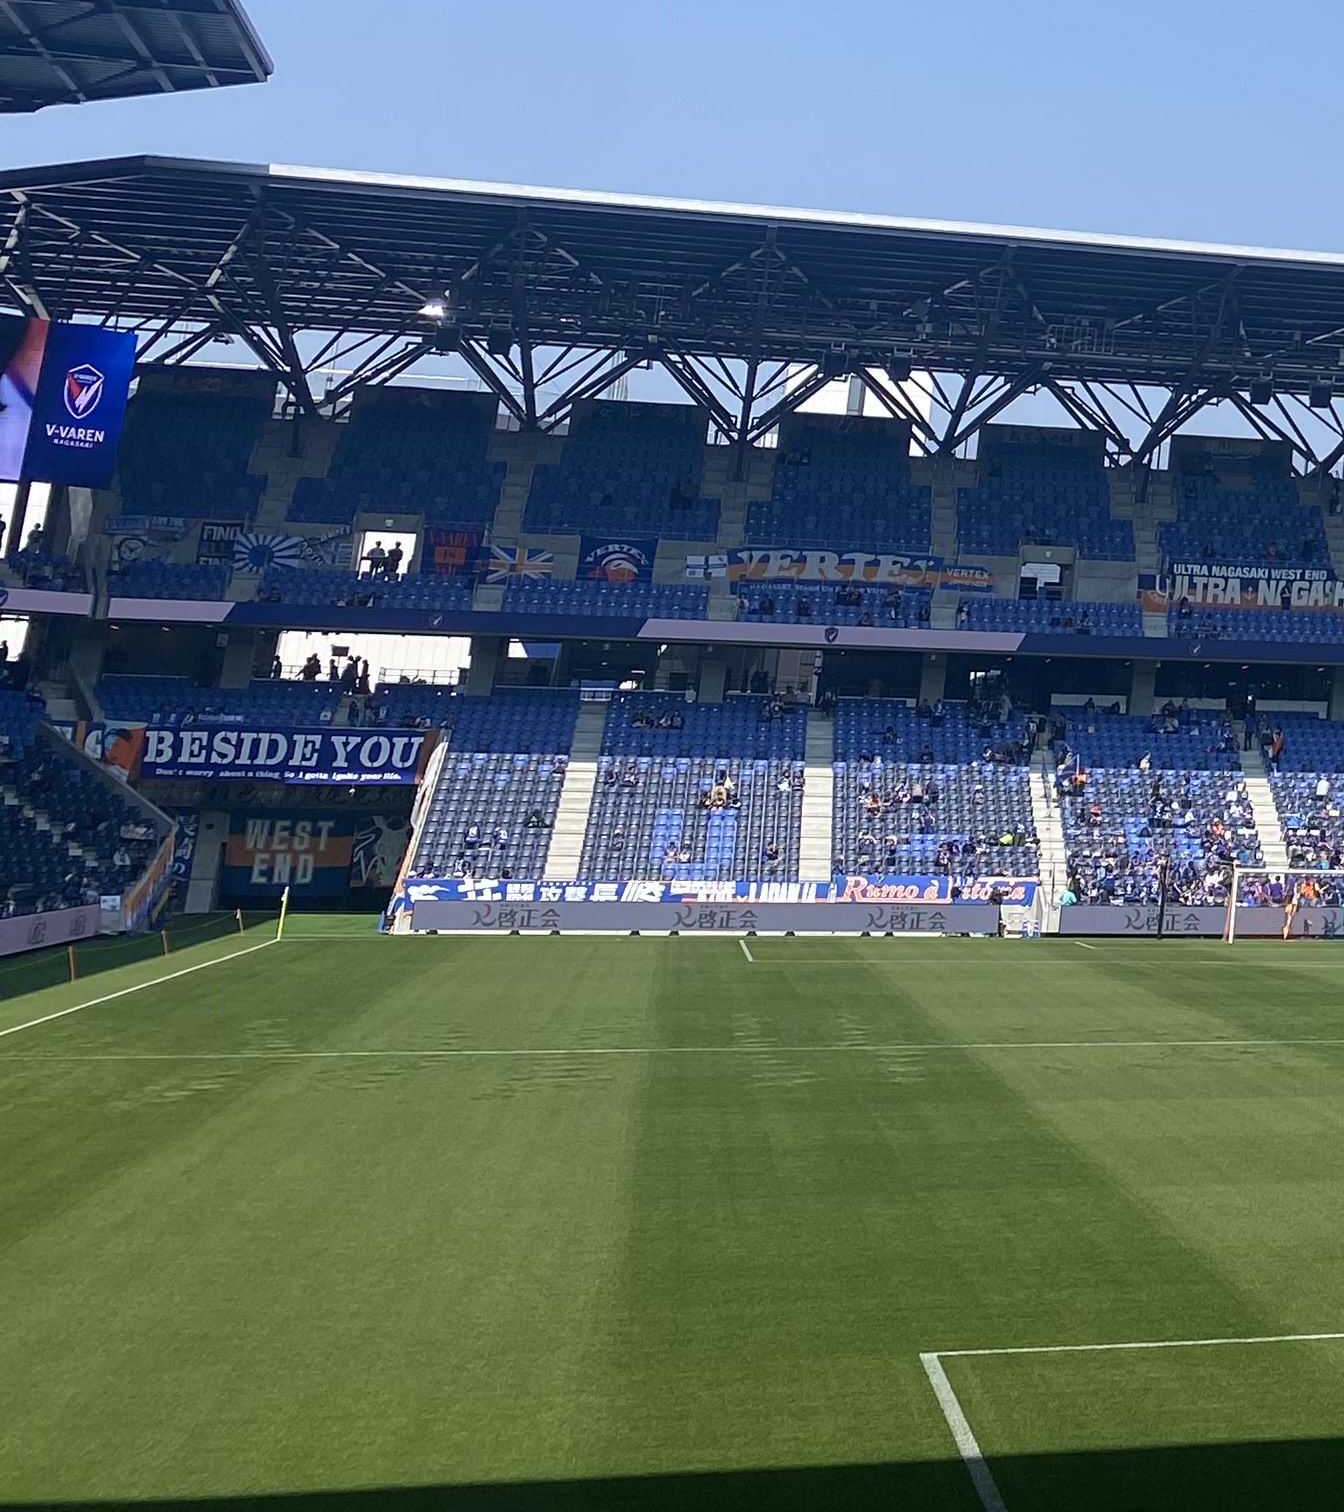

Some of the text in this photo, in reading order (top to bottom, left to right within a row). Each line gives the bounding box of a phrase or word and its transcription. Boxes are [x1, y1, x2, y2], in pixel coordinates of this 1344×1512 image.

[45, 423, 106, 443] V-VAREN
[584, 543, 649, 566] VERTEX
[946, 567, 989, 580] VERTEX
[1173, 563, 1328, 581] ULTRA NAGASAKI WEST END
[143, 729, 320, 768] BESIDE
[330, 734, 425, 769] YOU
[245, 818, 335, 852] WEST
[249, 852, 315, 886] END
[838, 876, 920, 903] Rumo
[498, 907, 561, 928] 啓正会
[696, 908, 759, 929] 啓正会
[888, 911, 947, 931] 啓正会
